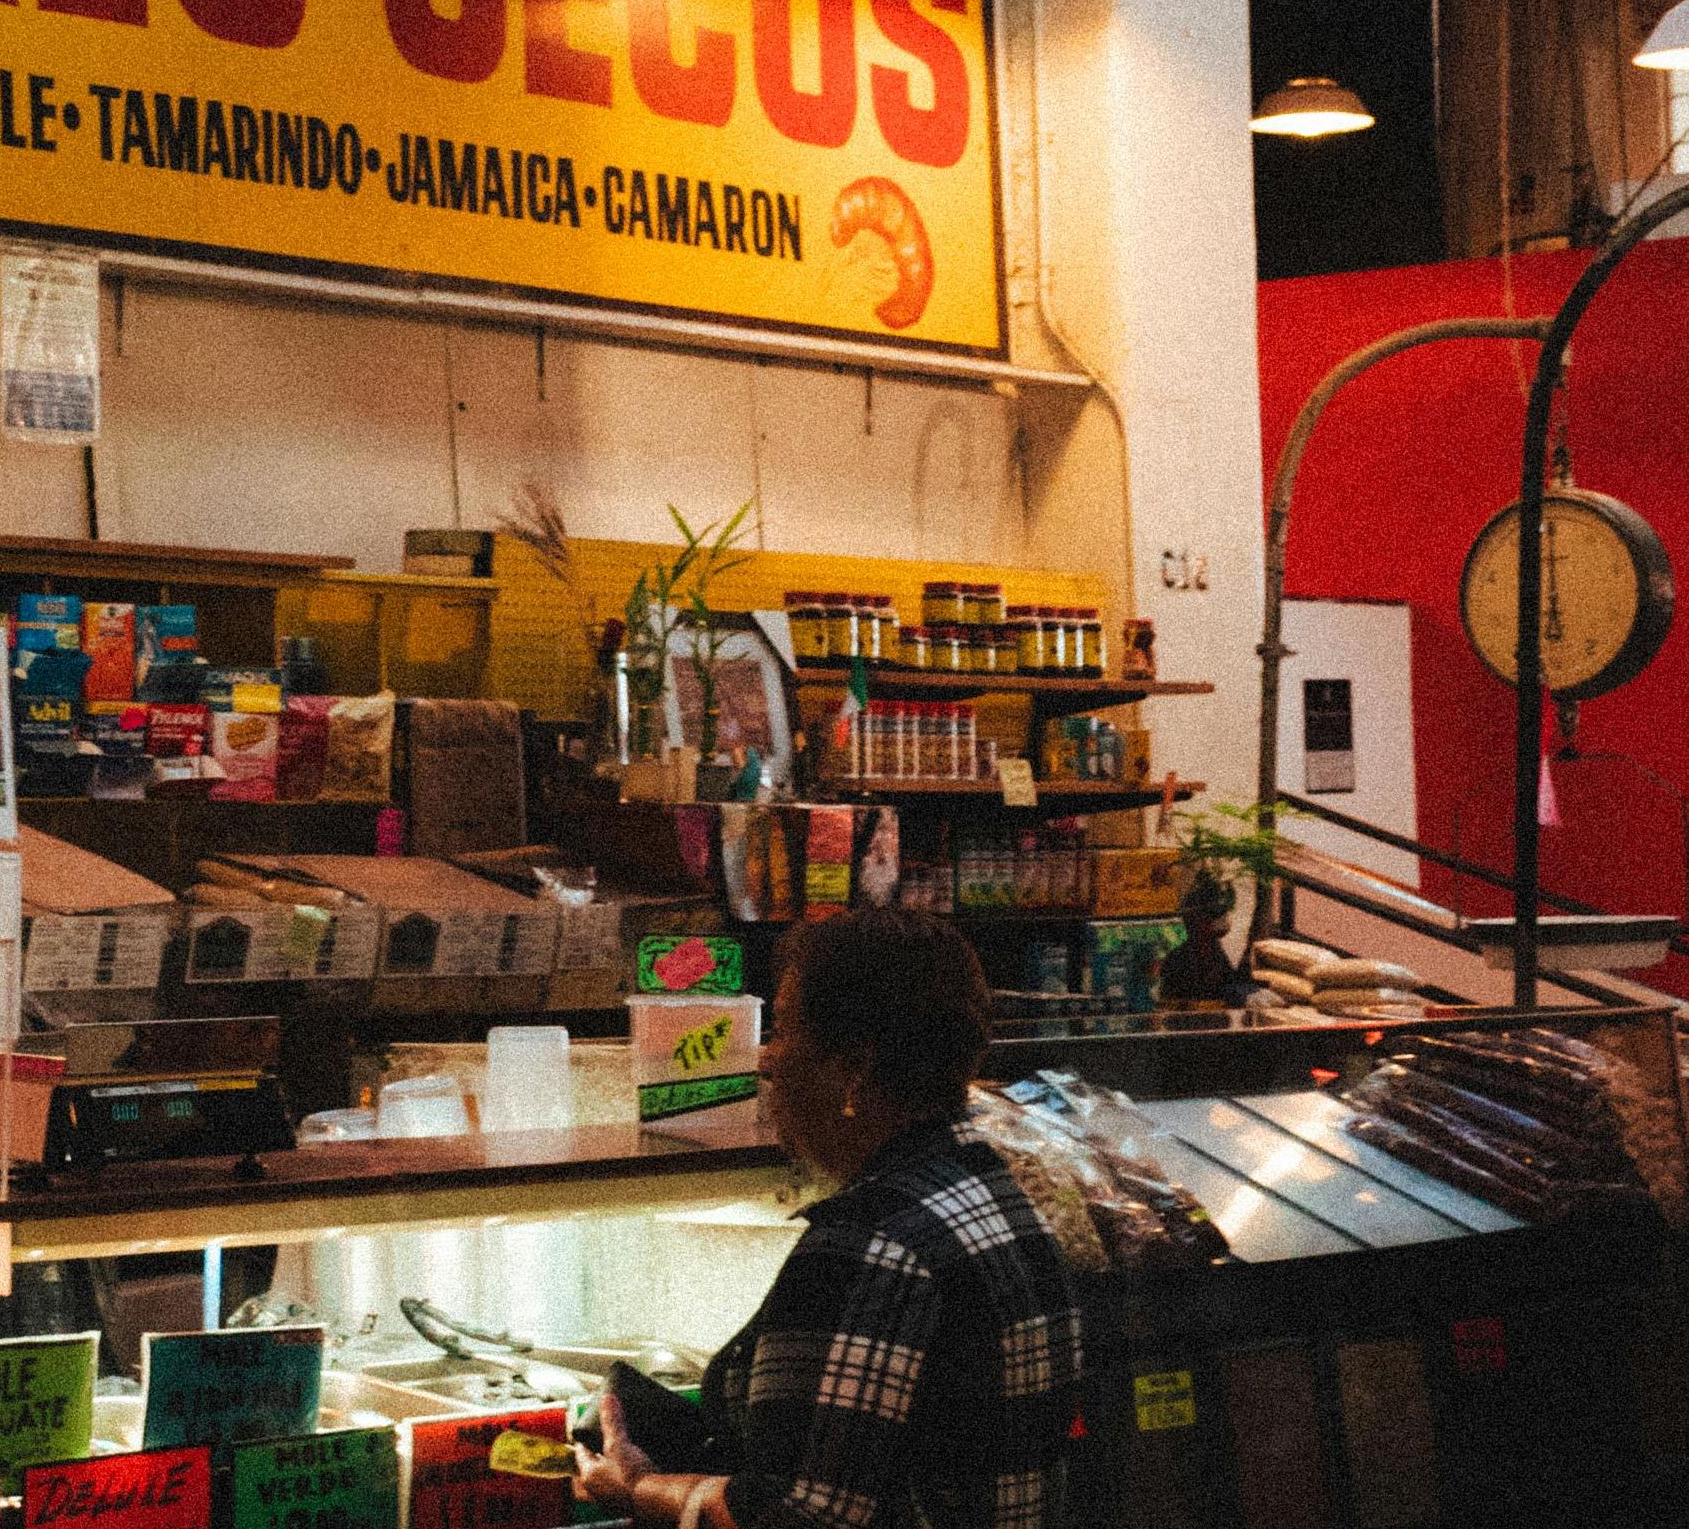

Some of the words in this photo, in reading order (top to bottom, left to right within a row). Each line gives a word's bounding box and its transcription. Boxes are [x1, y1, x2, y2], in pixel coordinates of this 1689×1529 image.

[89, 83, 363, 196] TAMARINDO
[385, 132, 581, 229] JAMAICA
[602, 165, 805, 261] CAMARON
[274, 1437, 349, 1471] MOLE
